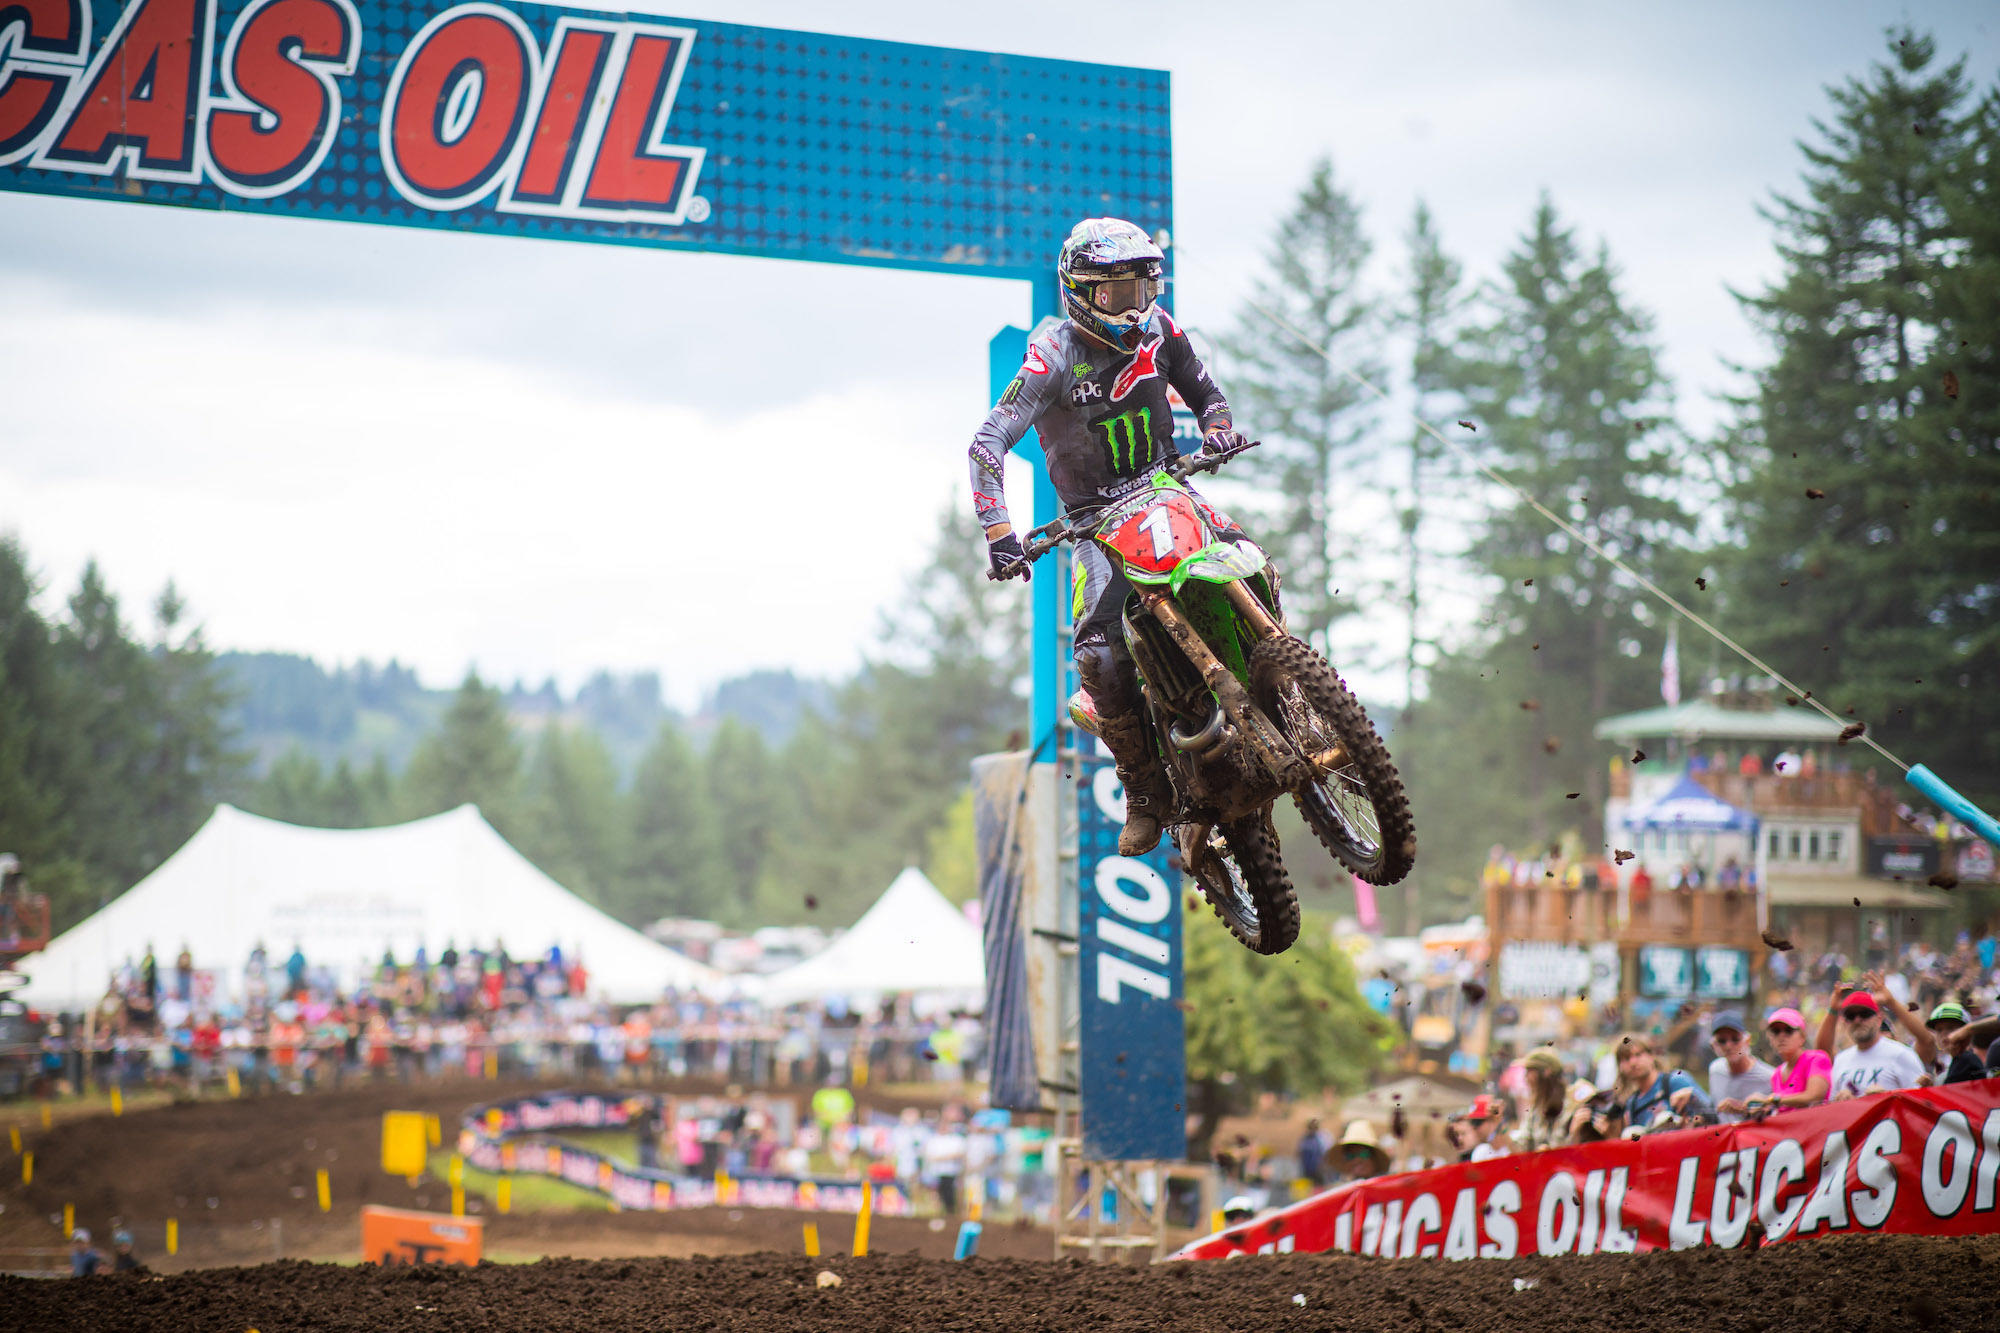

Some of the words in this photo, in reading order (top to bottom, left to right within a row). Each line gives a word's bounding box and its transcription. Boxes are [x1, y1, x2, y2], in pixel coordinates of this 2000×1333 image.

[379, 2, 707, 226] OIL
[1097, 460, 1167, 499] Kawasaki
[1137, 503, 1175, 564] 1
[1094, 854, 1172, 1005] OIL
[1536, 1166, 1639, 1258] OIL
[1668, 1118, 1902, 1252] LUCAS
